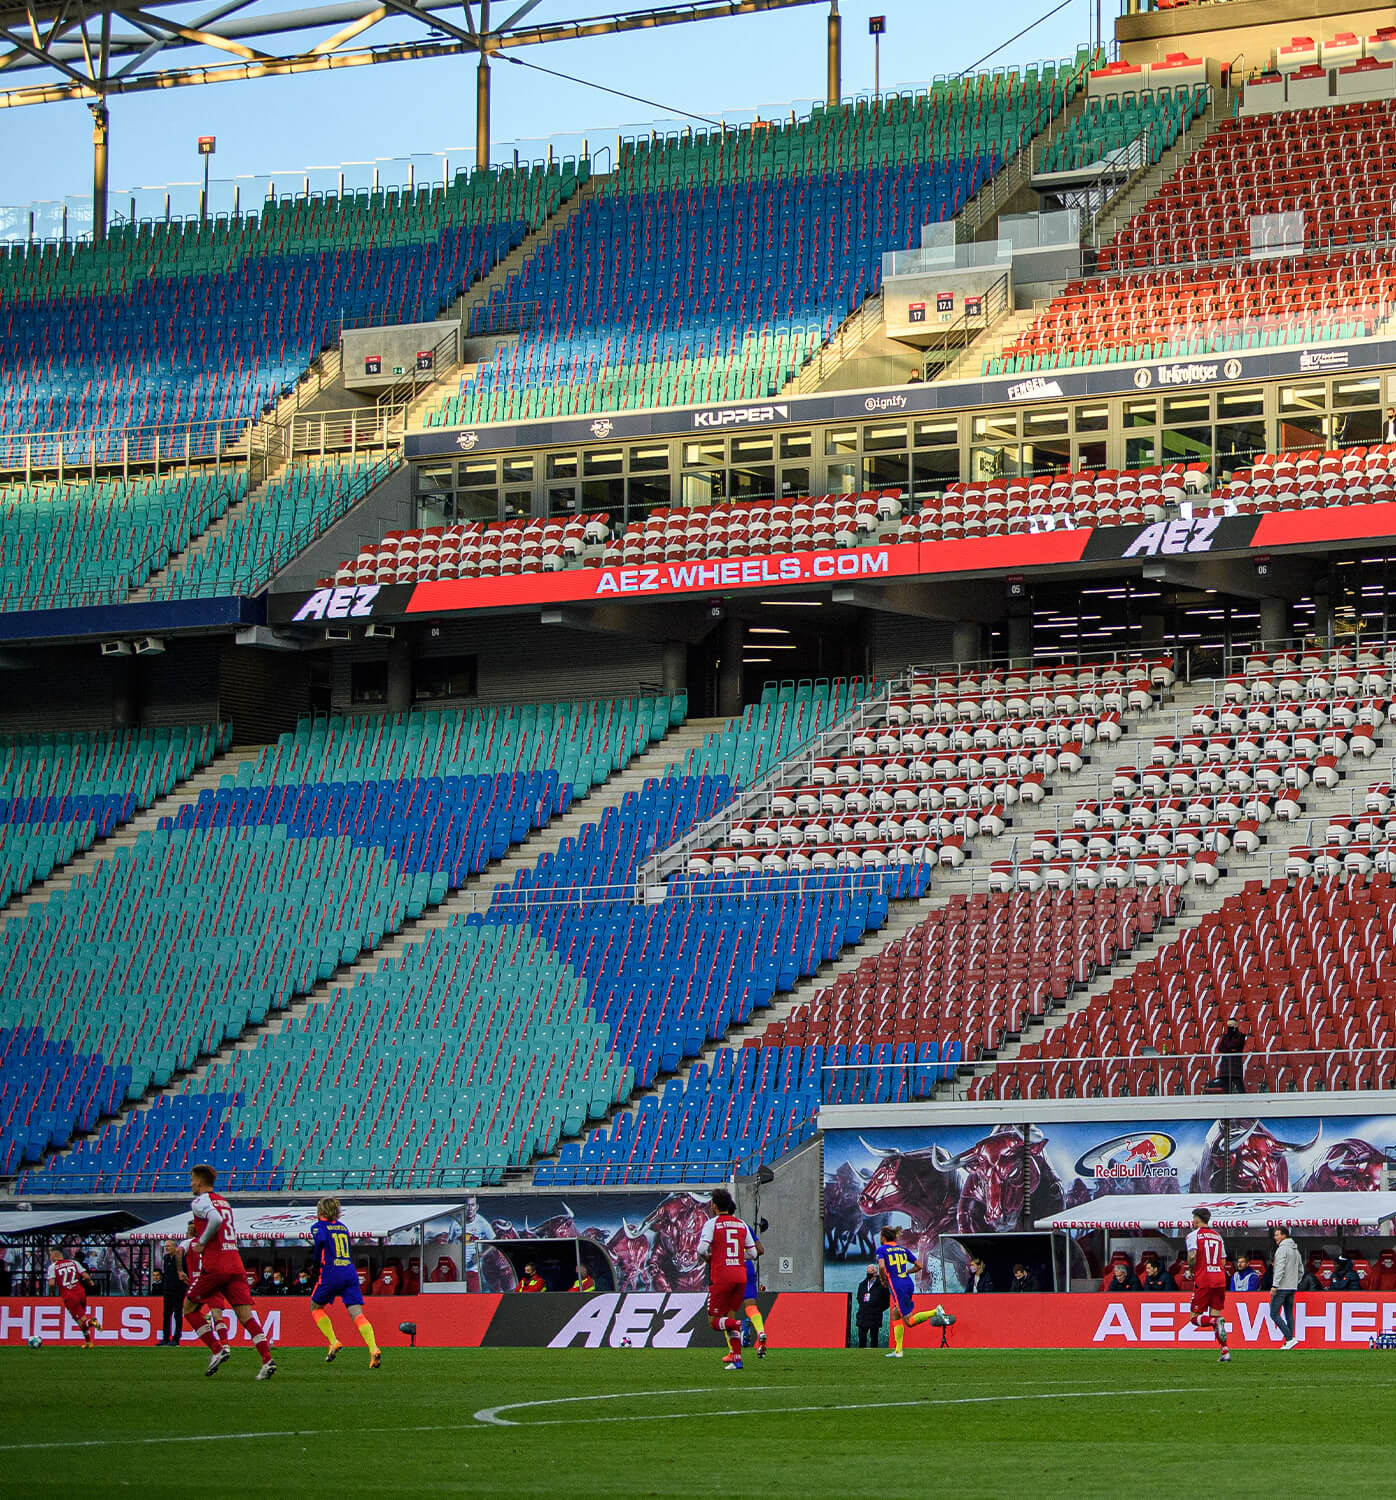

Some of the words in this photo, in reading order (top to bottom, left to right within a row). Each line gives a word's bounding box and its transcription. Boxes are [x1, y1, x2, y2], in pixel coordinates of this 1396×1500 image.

[939, 302, 952, 310] 17.1
[914, 311, 922, 321] 17
[694, 410, 775, 427] KUPPER
[1120, 518, 1222, 558] AEZ
[595, 551, 890, 594] AEZ-WHEELS.COM
[1257, 565, 1267, 575] 06
[291, 584, 382, 622] AEZ
[711, 607, 720, 617] 05
[431, 627, 440, 637] 04
[1095, 1164, 1117, 1177] Red
[1119, 1163, 1141, 1177] Bull
[1143, 1164, 1177, 1177] Arena
[221, 1208, 236, 1241] 3
[1052, 1221, 1068, 1229] DIE
[1104, 1221, 1141, 1229] BULLEN
[1212, 1220, 1249, 1229] BULLEN
[1321, 1218, 1360, 1227] BULLEN
[331, 1232, 351, 1259] 10
[726, 1229, 739, 1258] 5
[1203, 1239, 1219, 1266] 17
[887, 1252, 908, 1274] 44
[57, 1265, 80, 1288] 22
[546, 1292, 709, 1348] AEZ
